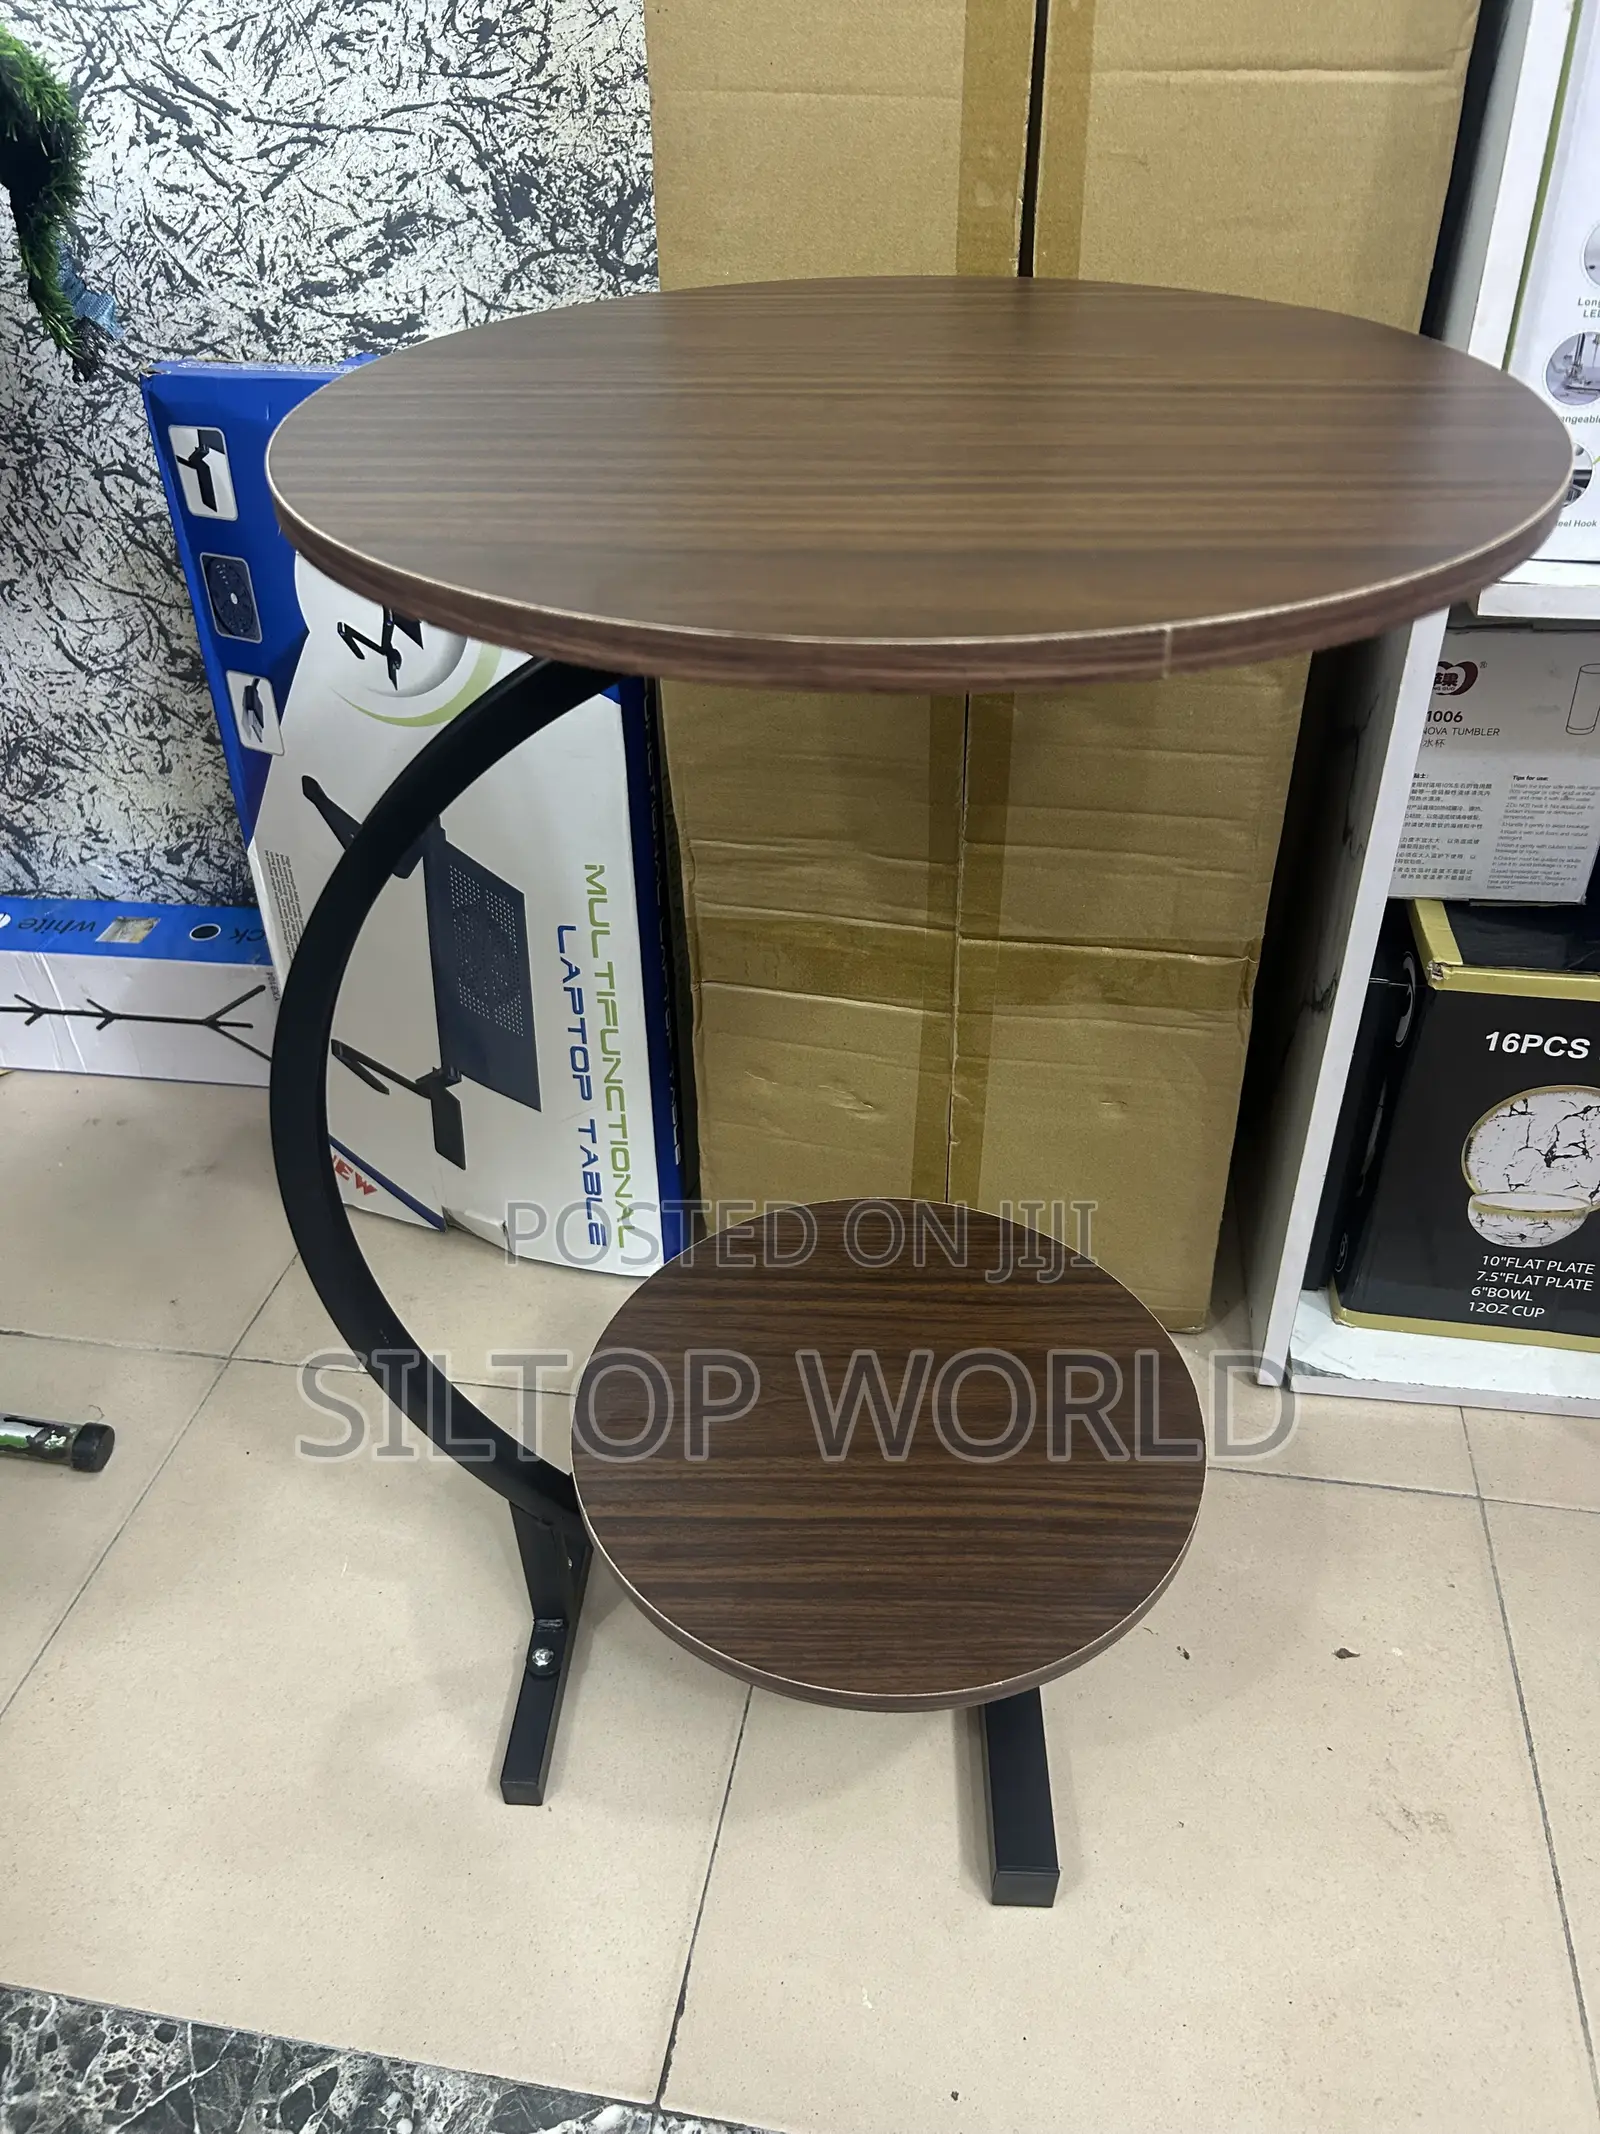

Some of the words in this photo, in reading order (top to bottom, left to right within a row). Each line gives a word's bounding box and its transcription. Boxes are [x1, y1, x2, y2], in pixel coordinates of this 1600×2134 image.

[1557, 520, 1572, 528] eel
[1574, 520, 1598, 528] Hook
[1452, 728, 1500, 736] TUMBLER
[18, 915, 97, 940] white
[1485, 1031, 1591, 1059] 16PCS
[557, 924, 594, 1102] LAPTOP
[578, 1123, 609, 1247] TABLE
[1548, 1260, 1596, 1275] PLATE
[1545, 1276, 1594, 1292] PLATE
[1471, 1286, 1533, 1301] 6"BOWL
[1511, 1304, 1545, 1318] CUP
